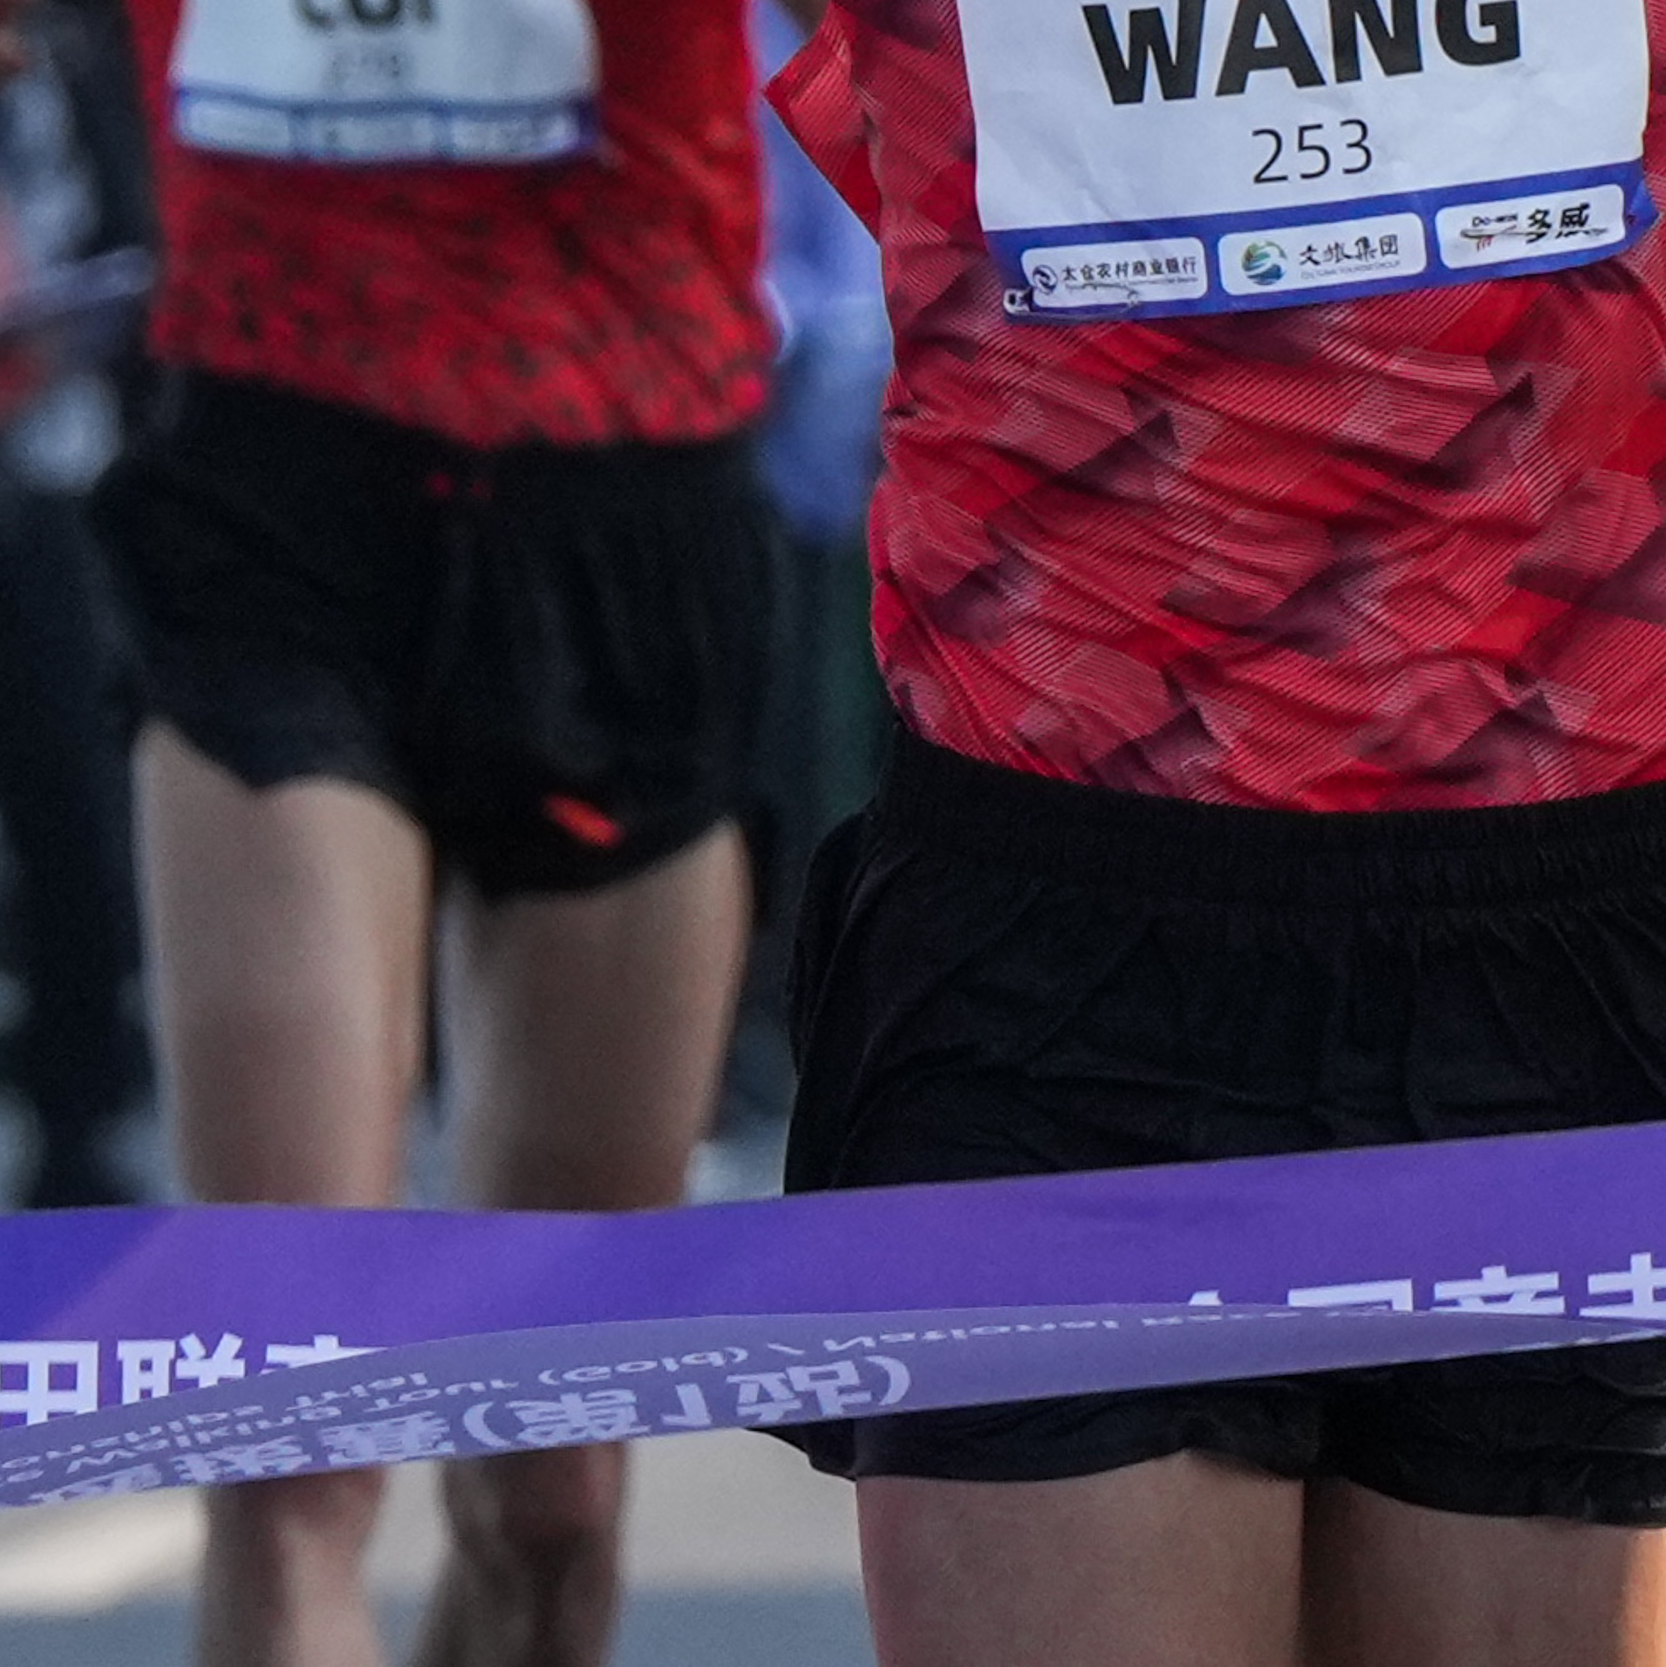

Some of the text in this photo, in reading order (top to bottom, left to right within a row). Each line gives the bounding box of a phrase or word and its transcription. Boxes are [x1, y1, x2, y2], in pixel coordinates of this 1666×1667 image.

[1251, 119, 1373, 184] 253
[1299, 234, 1399, 266] 文旅集团
[1061, 256, 1197, 281] 太仓农村商业银行
